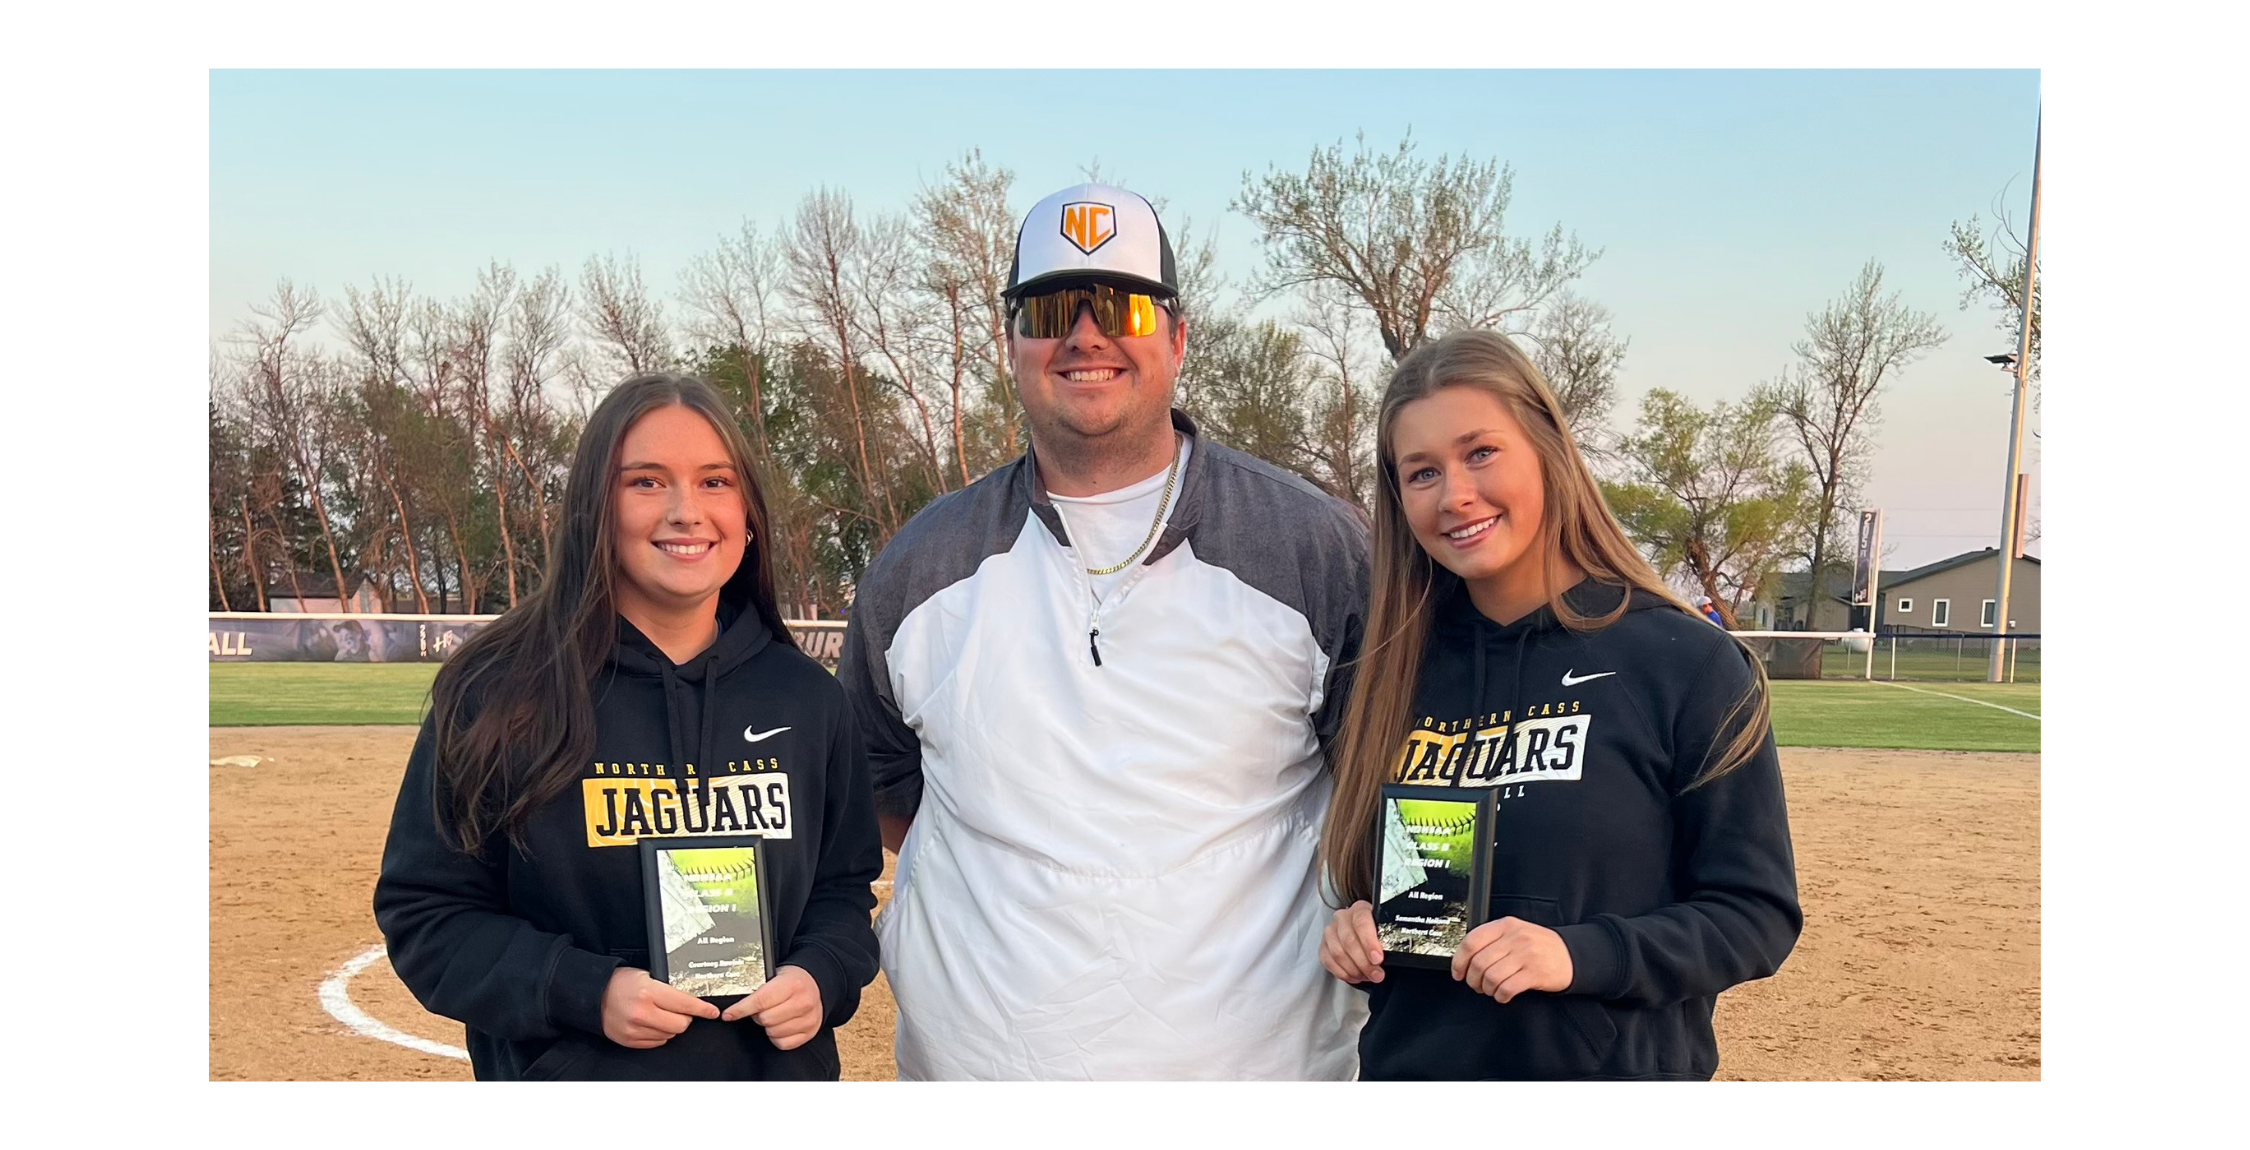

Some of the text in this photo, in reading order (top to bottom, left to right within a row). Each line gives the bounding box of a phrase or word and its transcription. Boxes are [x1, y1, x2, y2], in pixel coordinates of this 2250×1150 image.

[1065, 206, 1112, 248] NC
[1861, 513, 1872, 549] 205
[1415, 701, 1581, 733] ORTHERN CASS
[728, 757, 779, 773] CASS
[1394, 724, 1579, 783] JAGUARS
[596, 782, 786, 837] JAGUARS
